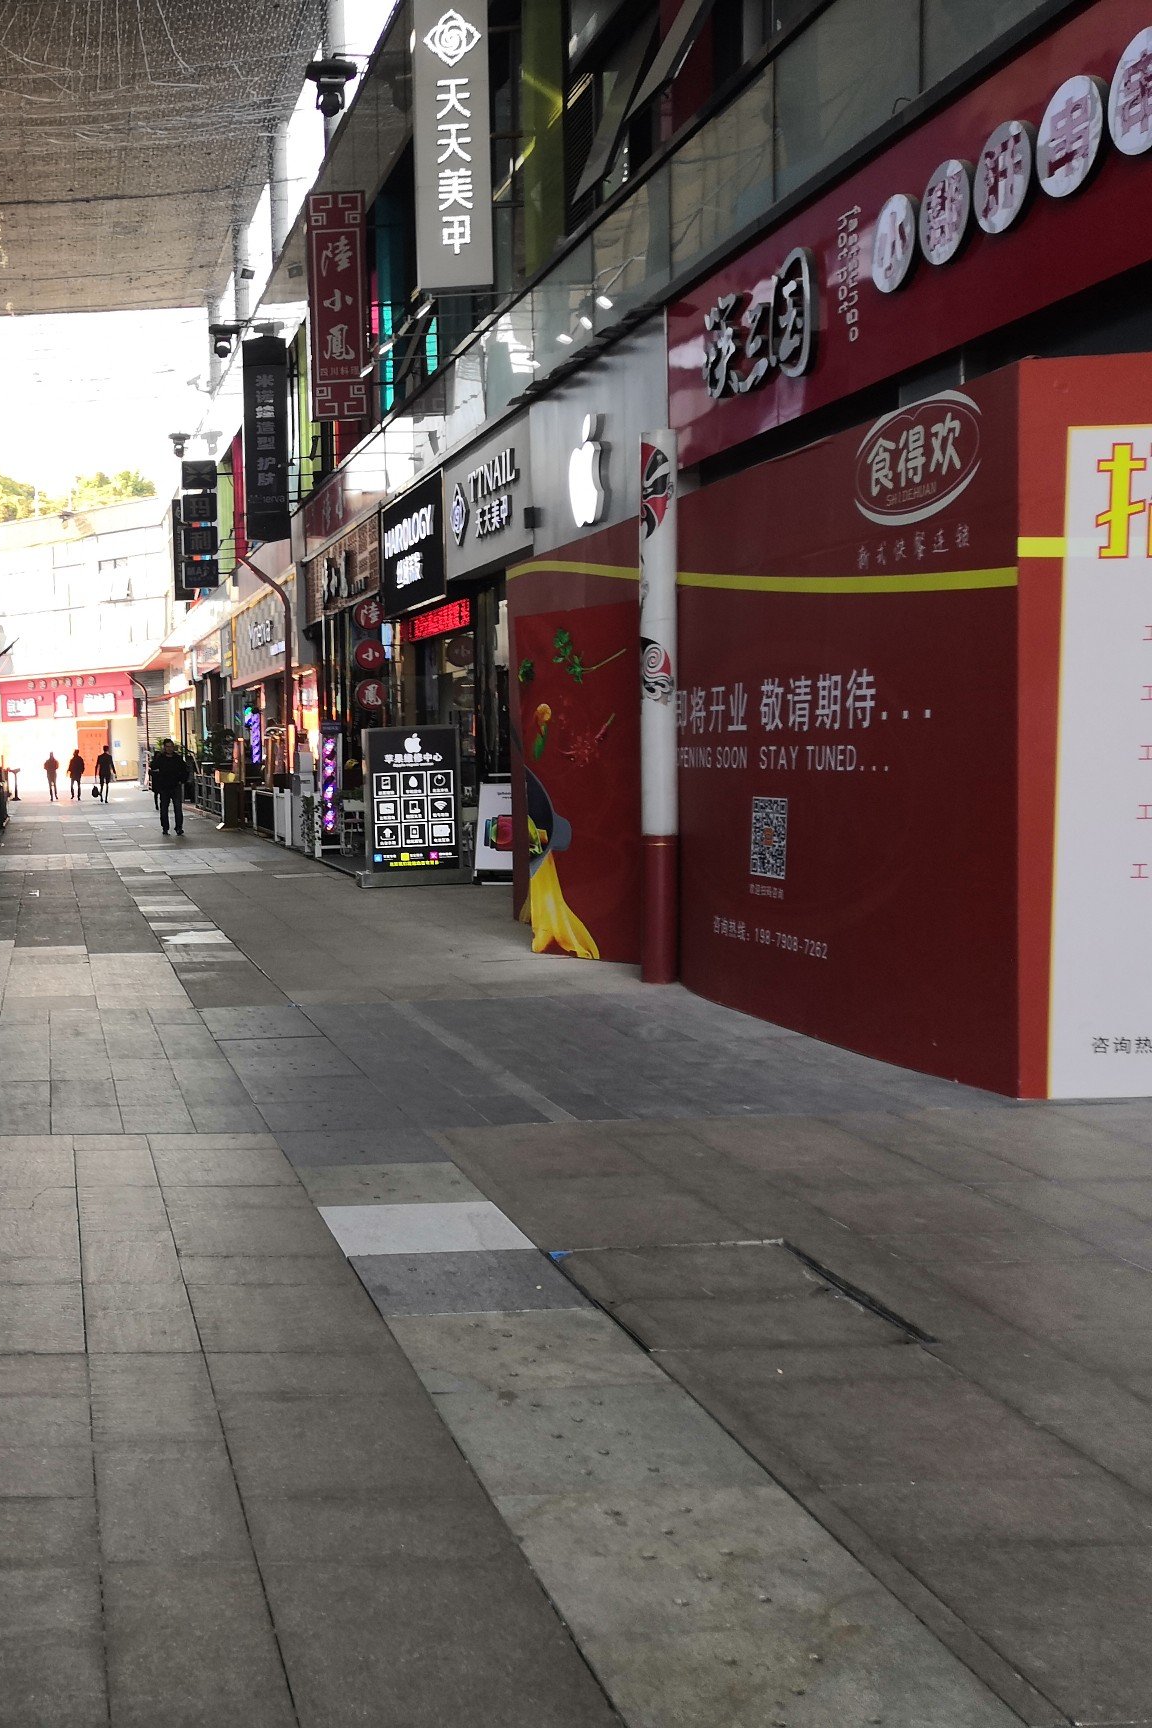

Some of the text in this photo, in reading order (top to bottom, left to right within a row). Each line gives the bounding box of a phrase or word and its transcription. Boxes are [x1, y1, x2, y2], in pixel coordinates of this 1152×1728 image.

[436, 77, 474, 255] 天天美甲
[468, 448, 516, 503] TTNAIL
[867, 412, 961, 497] 食得欢
[475, 495, 509, 537] 天天美甲
[676, 682, 748, 735] 即将开业
[677, 746, 712, 768] PENING
[716, 746, 748, 769] SOON
[760, 746, 799, 770] STAY
[1091, 1036, 1152, 1054] 咨询热
